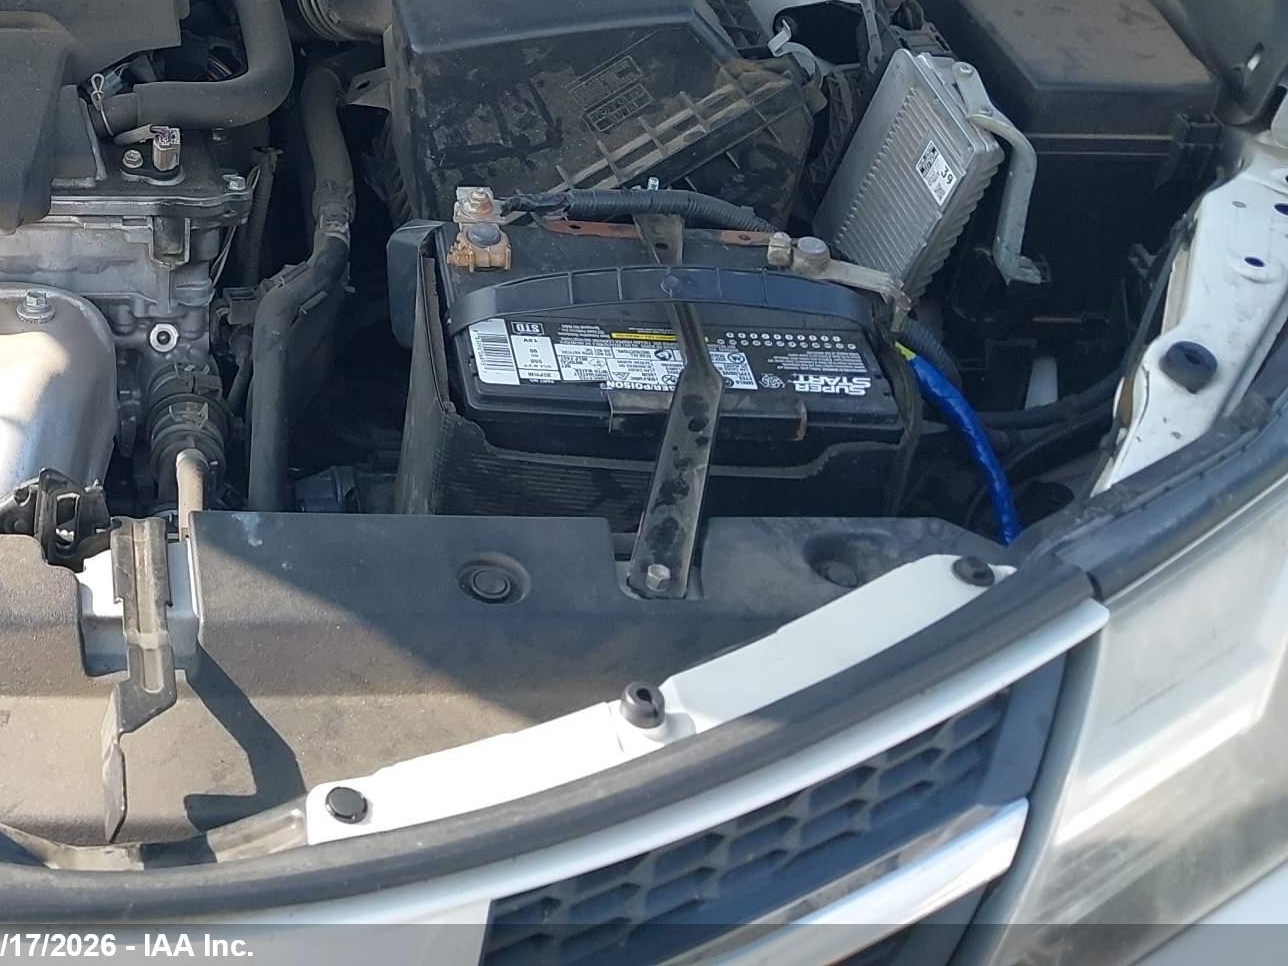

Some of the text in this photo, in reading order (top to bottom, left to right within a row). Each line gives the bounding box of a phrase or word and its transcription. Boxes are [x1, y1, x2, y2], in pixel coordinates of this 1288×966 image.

[940, 165, 954, 185] 39
[515, 322, 541, 332] STD
[793, 374, 872, 389] START
[795, 384, 867, 396] SUPER
